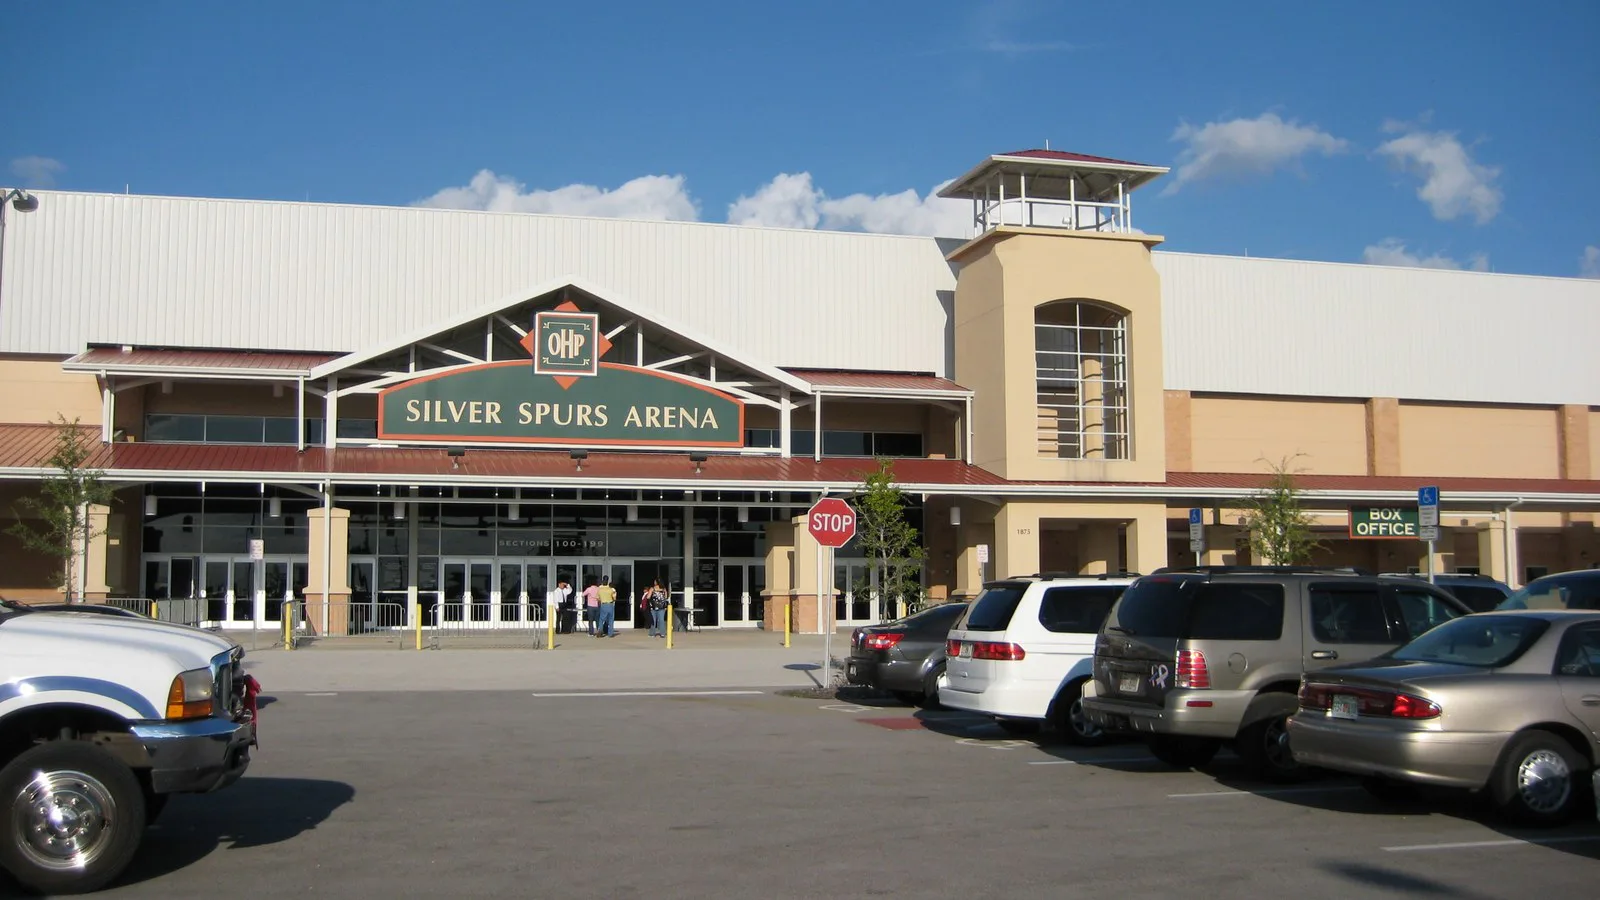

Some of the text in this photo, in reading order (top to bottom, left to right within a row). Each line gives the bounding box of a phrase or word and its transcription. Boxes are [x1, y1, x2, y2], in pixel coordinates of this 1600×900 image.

[547, 328, 586, 359] OHP
[406, 399, 719, 430] SILVER SPURS ARENA
[812, 513, 853, 533] STOP
[1369, 508, 1402, 521] BOX
[1356, 522, 1415, 536] OFFICE
[555, 540, 604, 548] 100-199
